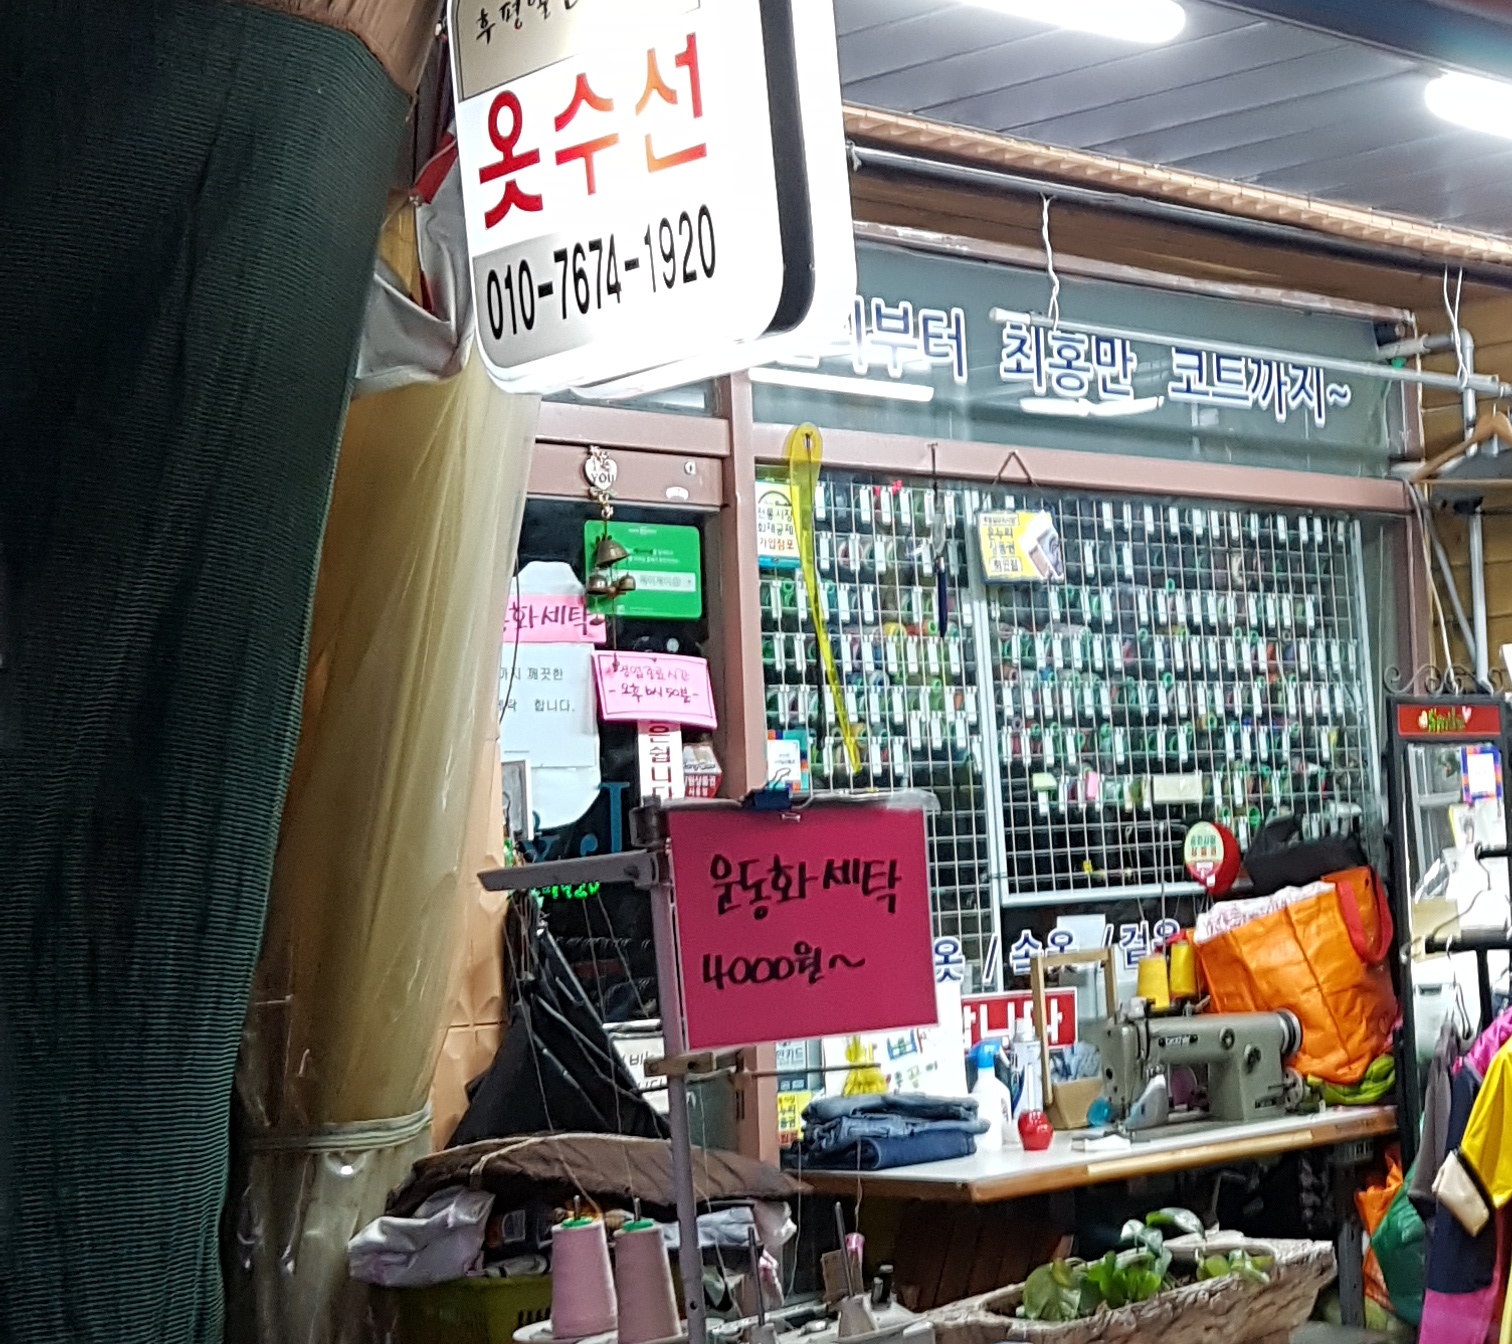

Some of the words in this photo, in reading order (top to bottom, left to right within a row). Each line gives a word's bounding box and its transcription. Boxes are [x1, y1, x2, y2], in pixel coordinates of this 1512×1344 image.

[478, 31, 709, 231] 옷수선
[486, 203, 717, 341] 010-7674-1920
[1001, 323, 1138, 402] 최홍만
[528, 667, 564, 681] 깨끗한
